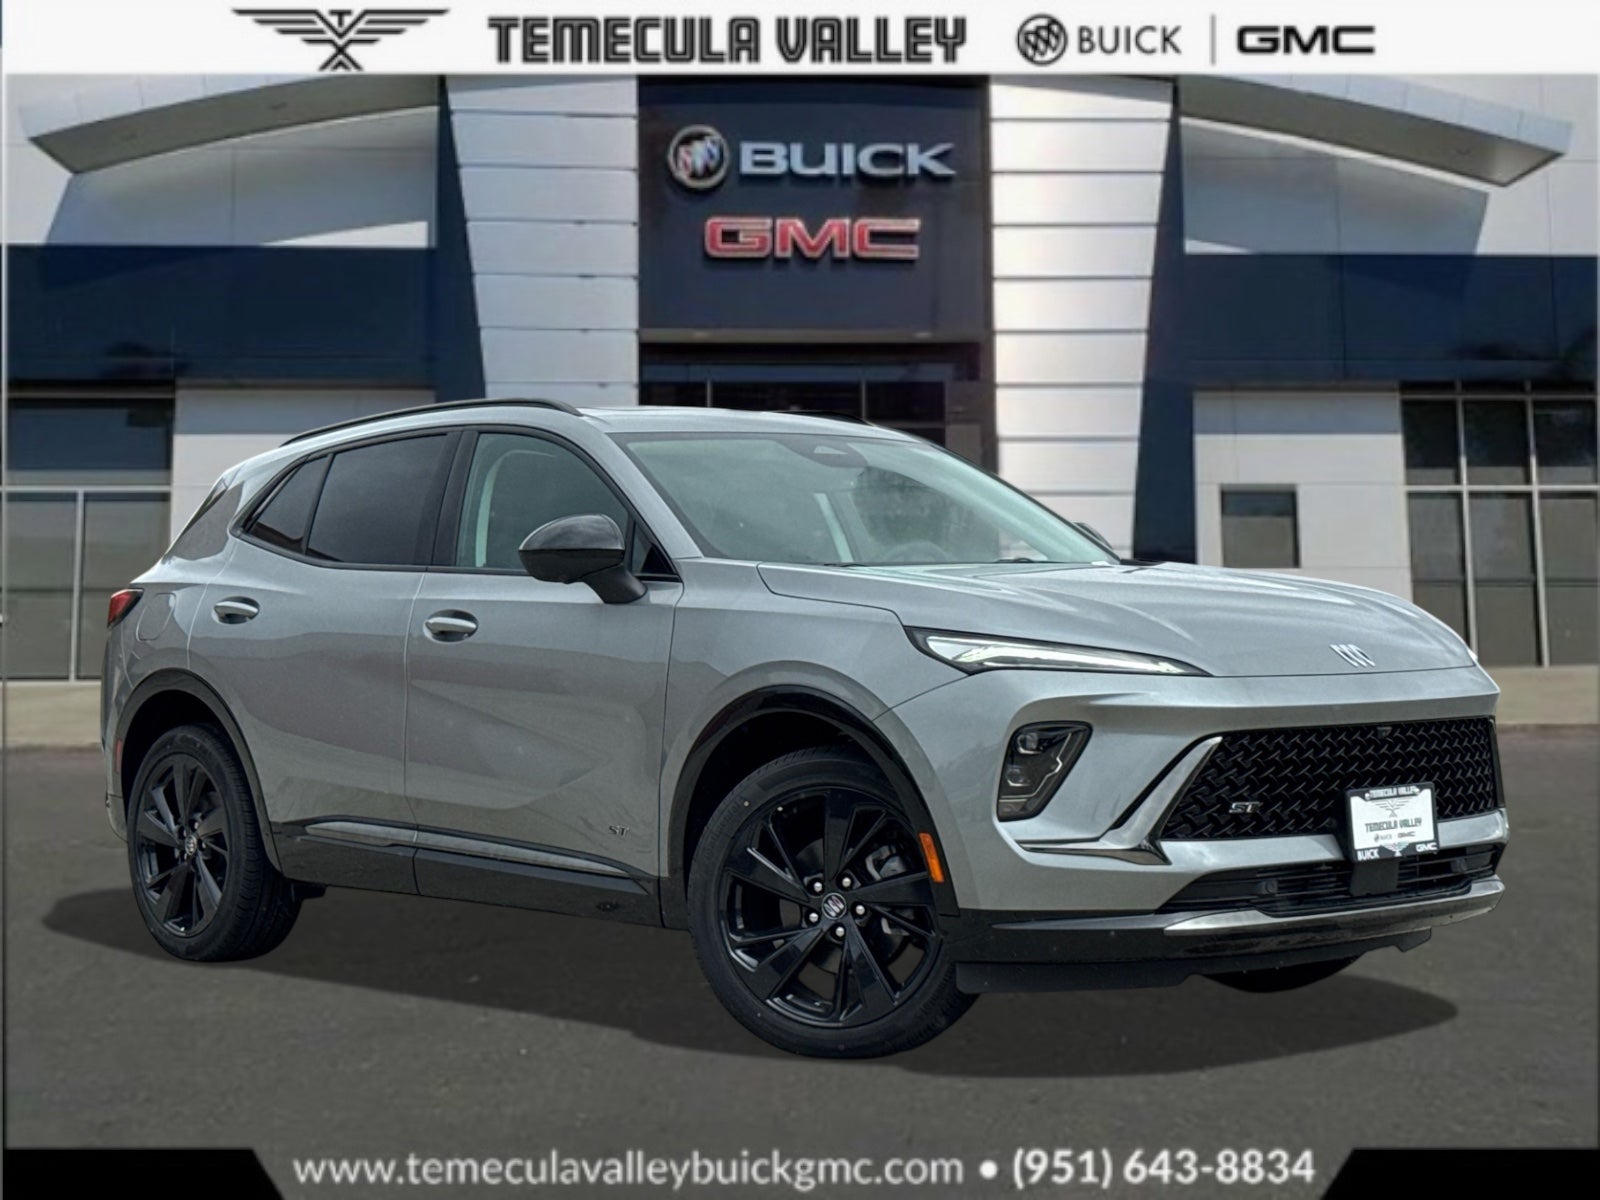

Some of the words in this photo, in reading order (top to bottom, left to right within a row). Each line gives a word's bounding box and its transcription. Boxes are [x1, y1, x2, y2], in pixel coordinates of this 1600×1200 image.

[739, 141, 956, 177] BUICK
[704, 216, 921, 260] GMC
[1365, 820, 1398, 832] TEMECULA
[1399, 817, 1422, 829] VALLEY
[1415, 842, 1438, 852] GMC
